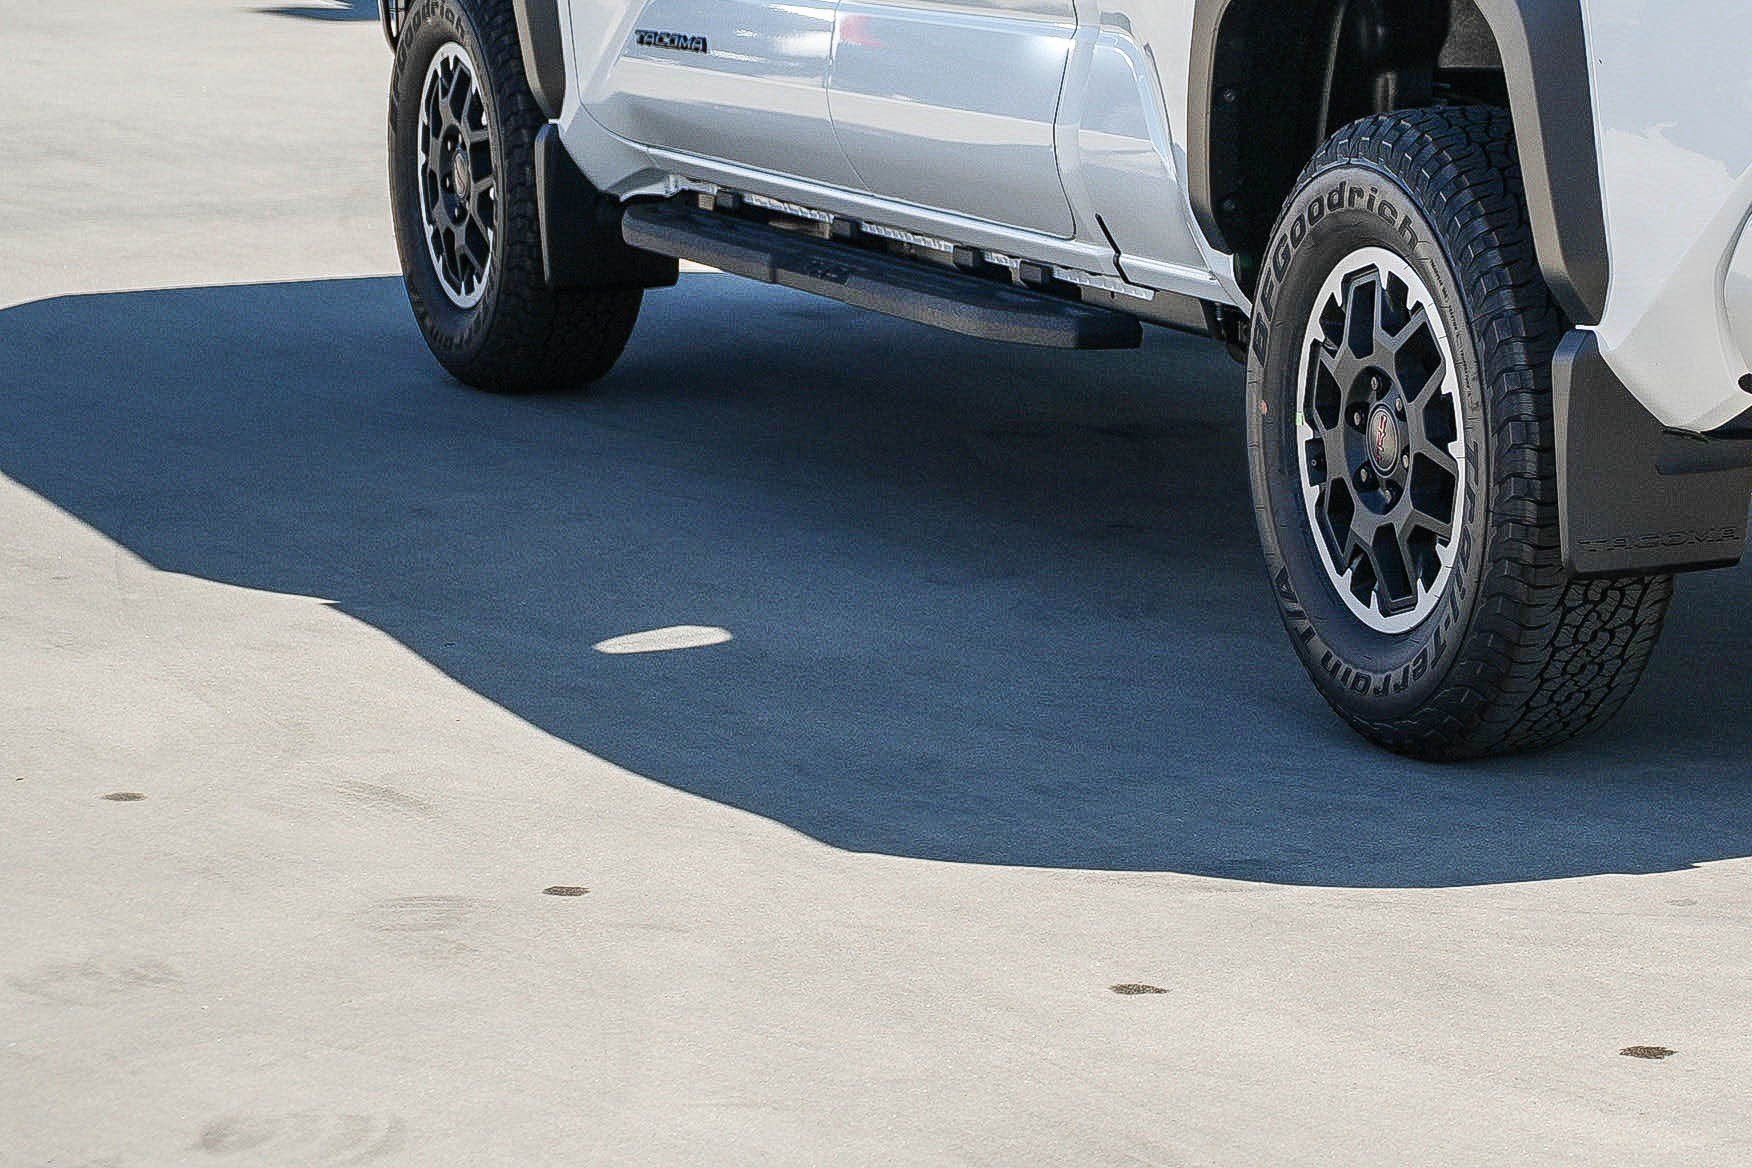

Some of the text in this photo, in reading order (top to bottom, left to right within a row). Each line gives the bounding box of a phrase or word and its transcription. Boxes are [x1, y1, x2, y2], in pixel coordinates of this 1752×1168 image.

[635, 29, 708, 54] TACOMA
[1252, 181, 1419, 368] BFGoodrich
[1576, 526, 1741, 552] TACOMA
